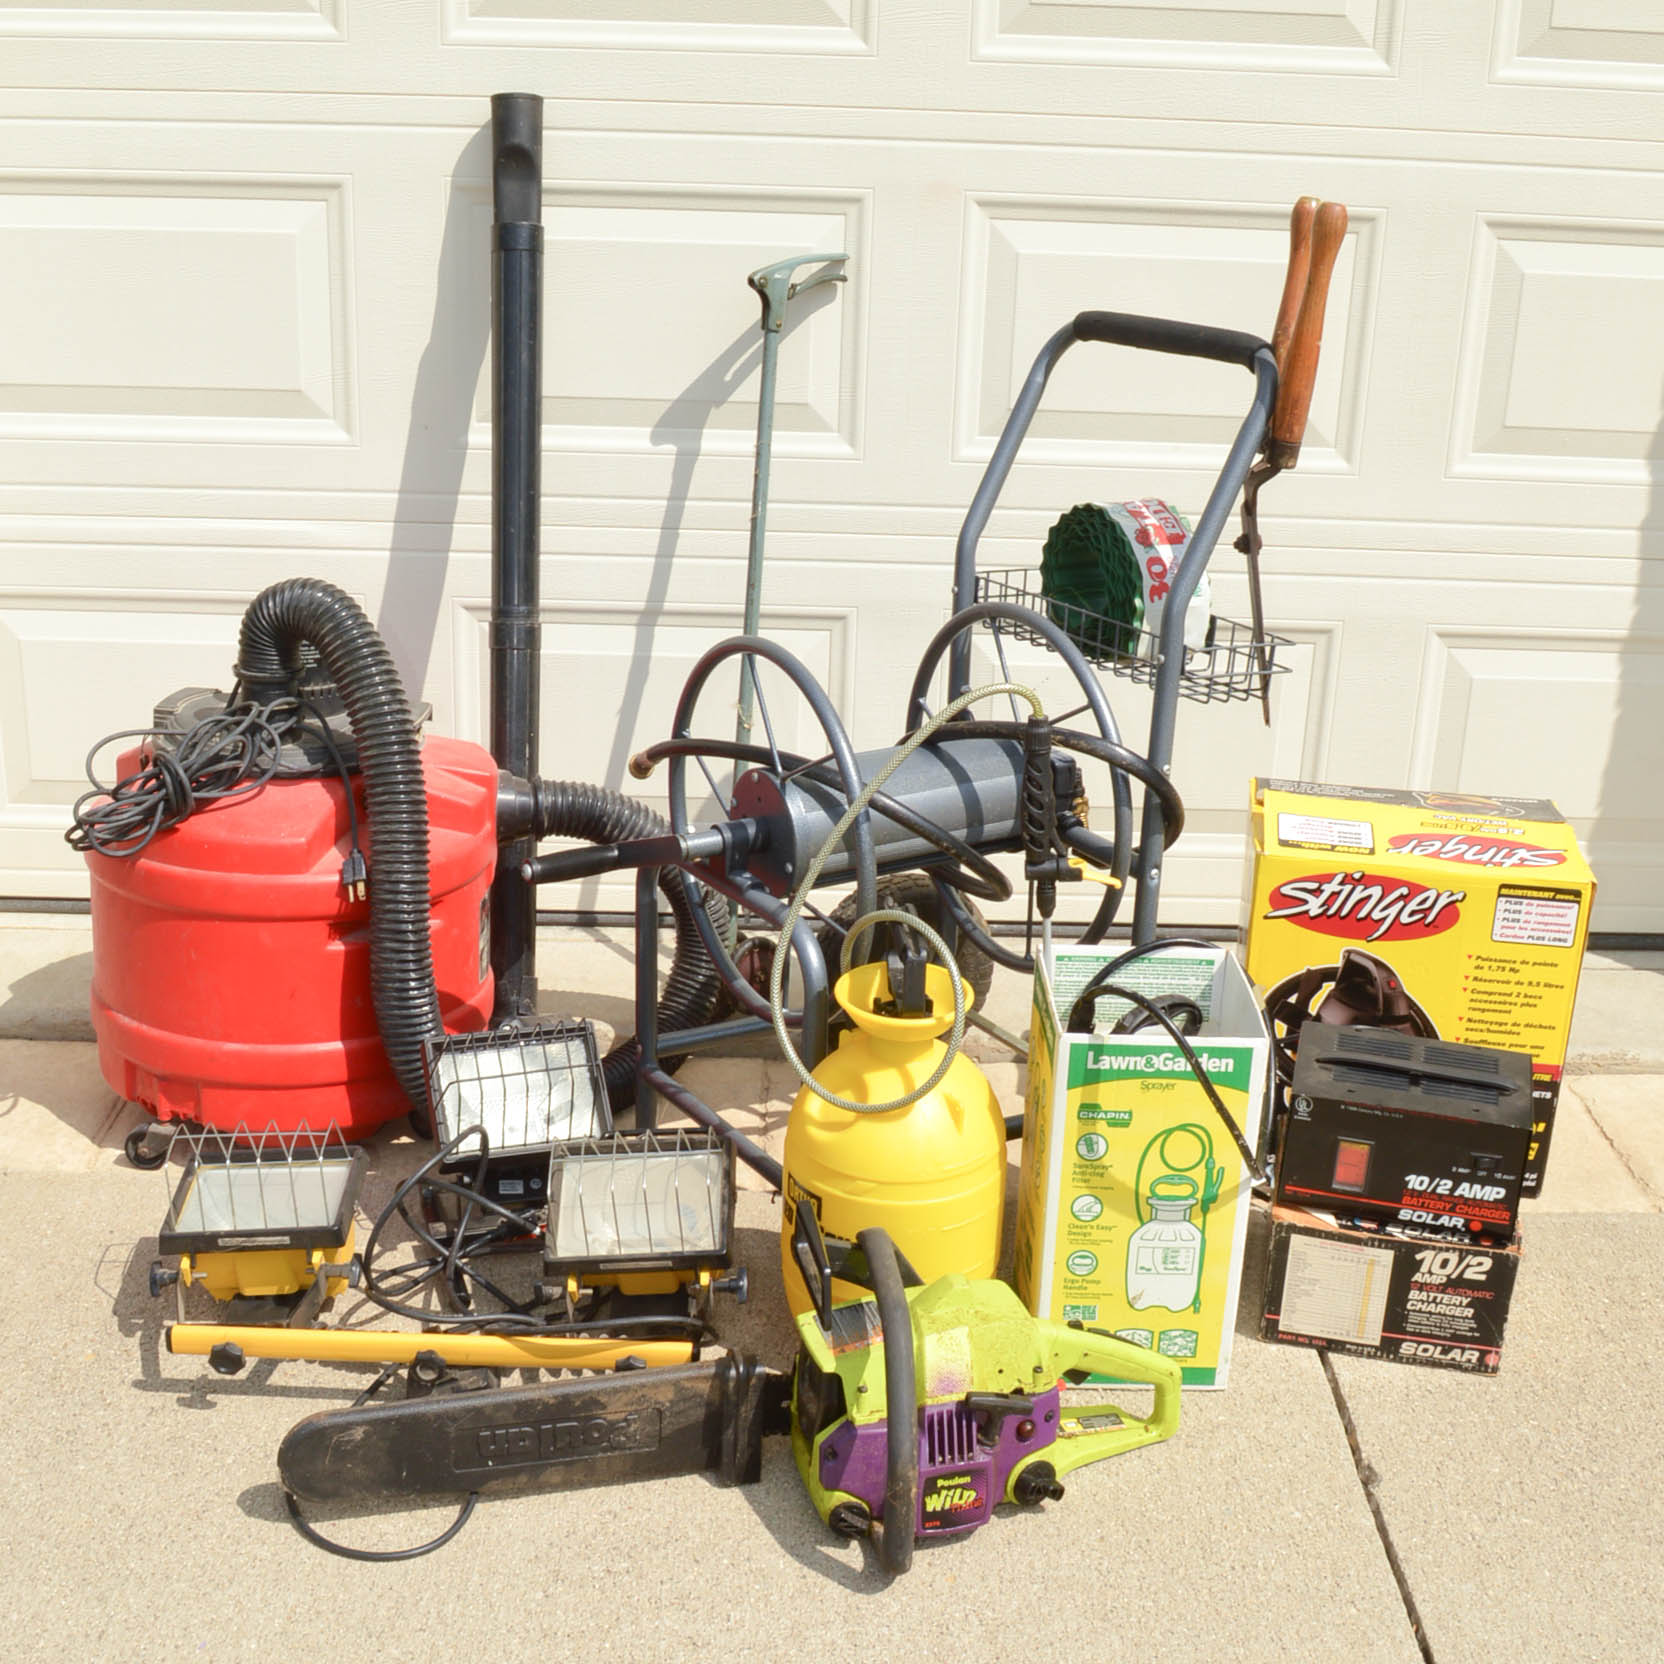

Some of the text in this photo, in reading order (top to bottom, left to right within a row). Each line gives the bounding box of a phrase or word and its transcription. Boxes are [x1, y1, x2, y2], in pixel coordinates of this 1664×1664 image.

[1263, 871, 1466, 942] Stinger
[1140, 1080, 1176, 1092] Sprayer
[1079, 1111, 1130, 1119] CHAPIN
[1404, 1174, 1506, 1201] 10/2 AMP
[1402, 1196, 1512, 1220] BATTERY CHARGER
[1398, 1208, 1465, 1229] SOLAR
[1415, 1250, 1493, 1281] 10/2
[1411, 1272, 1448, 1285] AMP
[1408, 1290, 1472, 1306] BATTERY
[1423, 1284, 1444, 1293] VOLT
[1446, 1286, 1495, 1300] AUTOMATIC
[1406, 1300, 1475, 1318] CHARGER
[1399, 1342, 1480, 1363] SOLAR
[937, 1475, 971, 1488] Poulan
